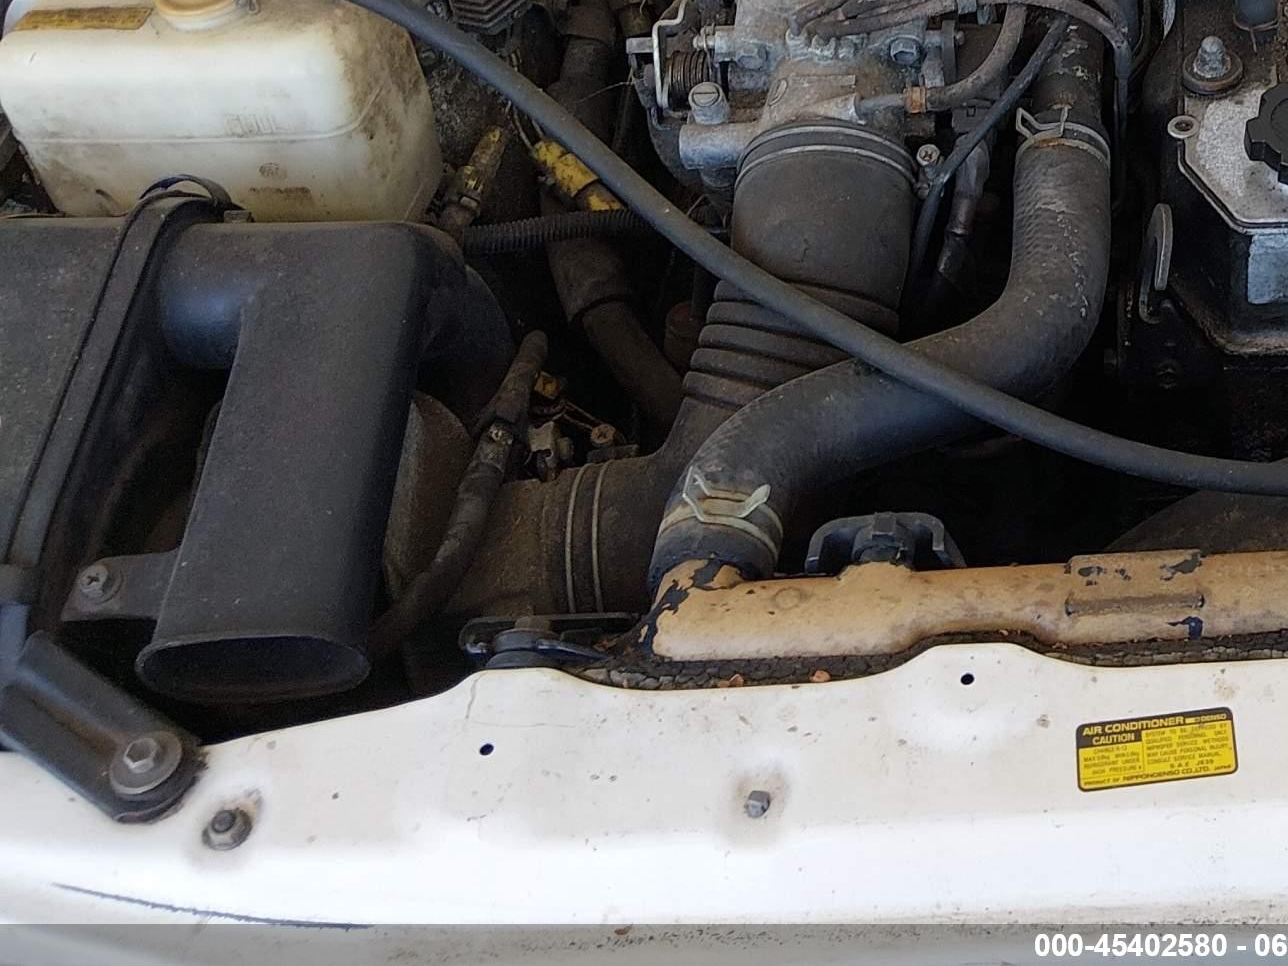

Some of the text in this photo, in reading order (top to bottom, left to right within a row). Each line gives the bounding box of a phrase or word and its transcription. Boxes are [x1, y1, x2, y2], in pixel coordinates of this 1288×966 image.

[1082, 725, 1103, 736] AIR
[1106, 716, 1185, 733] CONDITIONER
[1092, 732, 1135, 746] CAUTION
